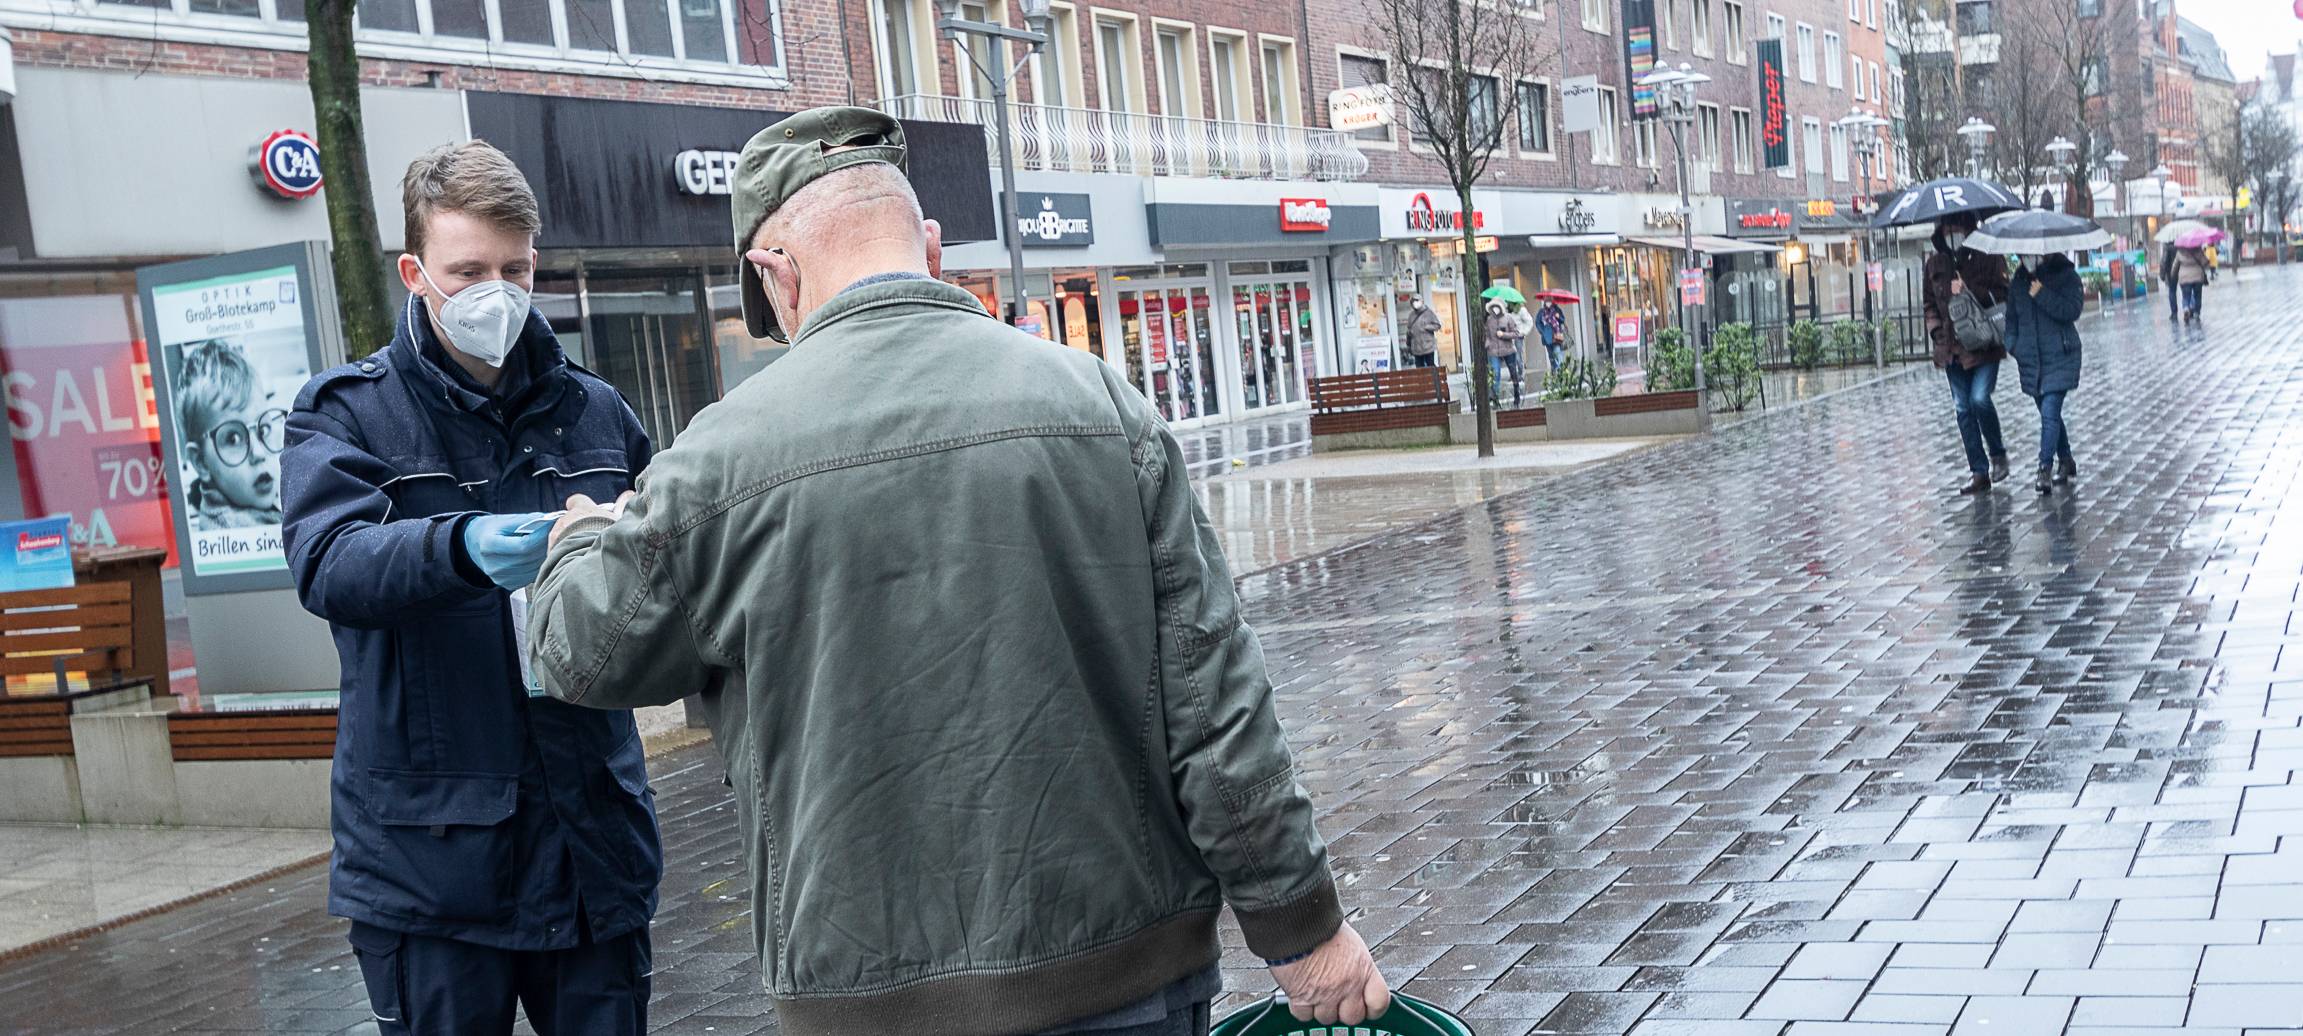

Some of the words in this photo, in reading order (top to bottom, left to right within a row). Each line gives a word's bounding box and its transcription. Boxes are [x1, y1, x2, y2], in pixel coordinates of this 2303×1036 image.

[275, 145, 320, 178] C&A
[1018, 218, 1040, 237] IJOU
[201, 285, 251, 303] OPTIK
[185, 299, 276, 324] Groß-Blotekamp
[2, 361, 160, 442] SALE
[198, 535, 250, 557] Brillen
